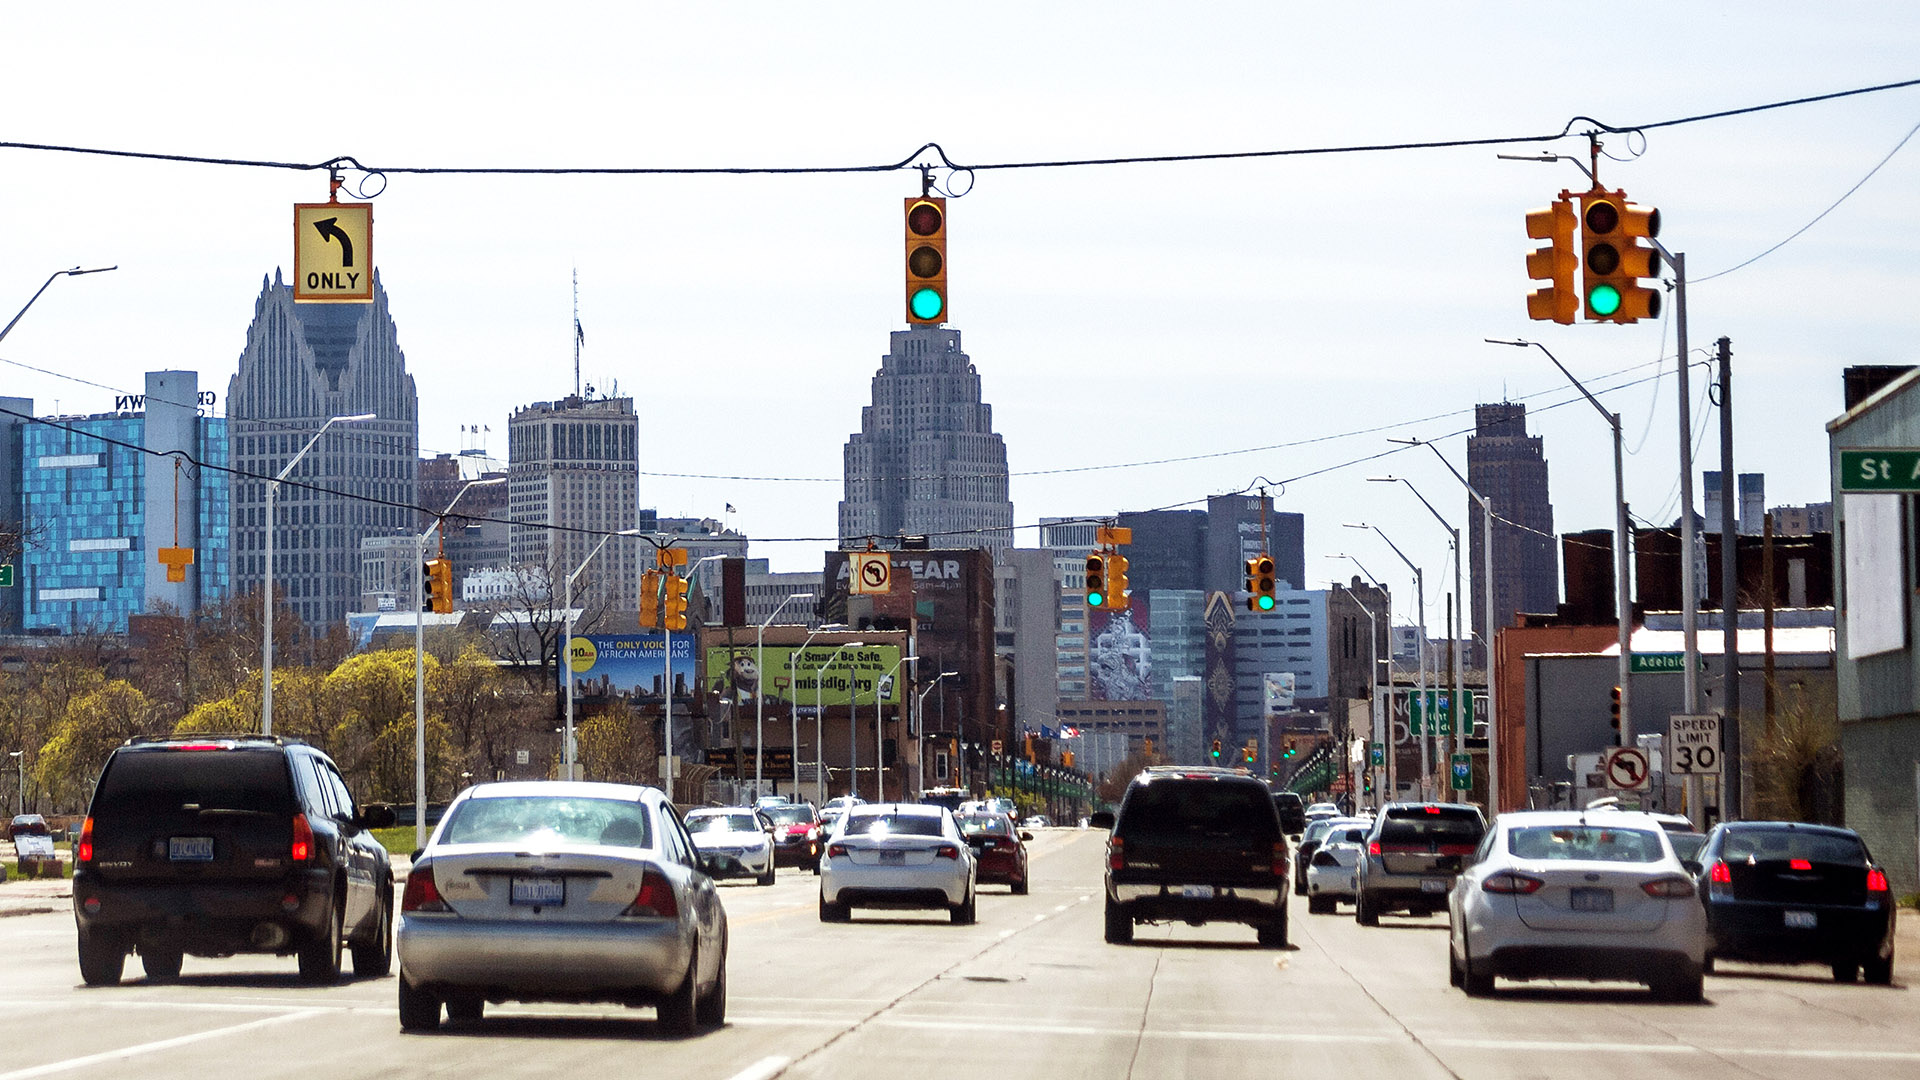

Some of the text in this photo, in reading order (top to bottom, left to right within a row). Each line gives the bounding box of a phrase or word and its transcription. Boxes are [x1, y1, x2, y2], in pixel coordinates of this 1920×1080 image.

[307, 272, 360, 289] ONLY
[1860, 458, 1892, 480] St
[598, 641, 690, 649] THE ONLY VOIC FOR
[598, 650, 690, 658] AFRICAN AMERIANS
[841, 652, 854, 662] Be
[857, 652, 882, 662] Safe.
[1673, 720, 1716, 731] SPEED
[1677, 733, 1711, 743] LIMIT
[1676, 746, 1715, 768] 30
[1453, 764, 1469, 773] 75
